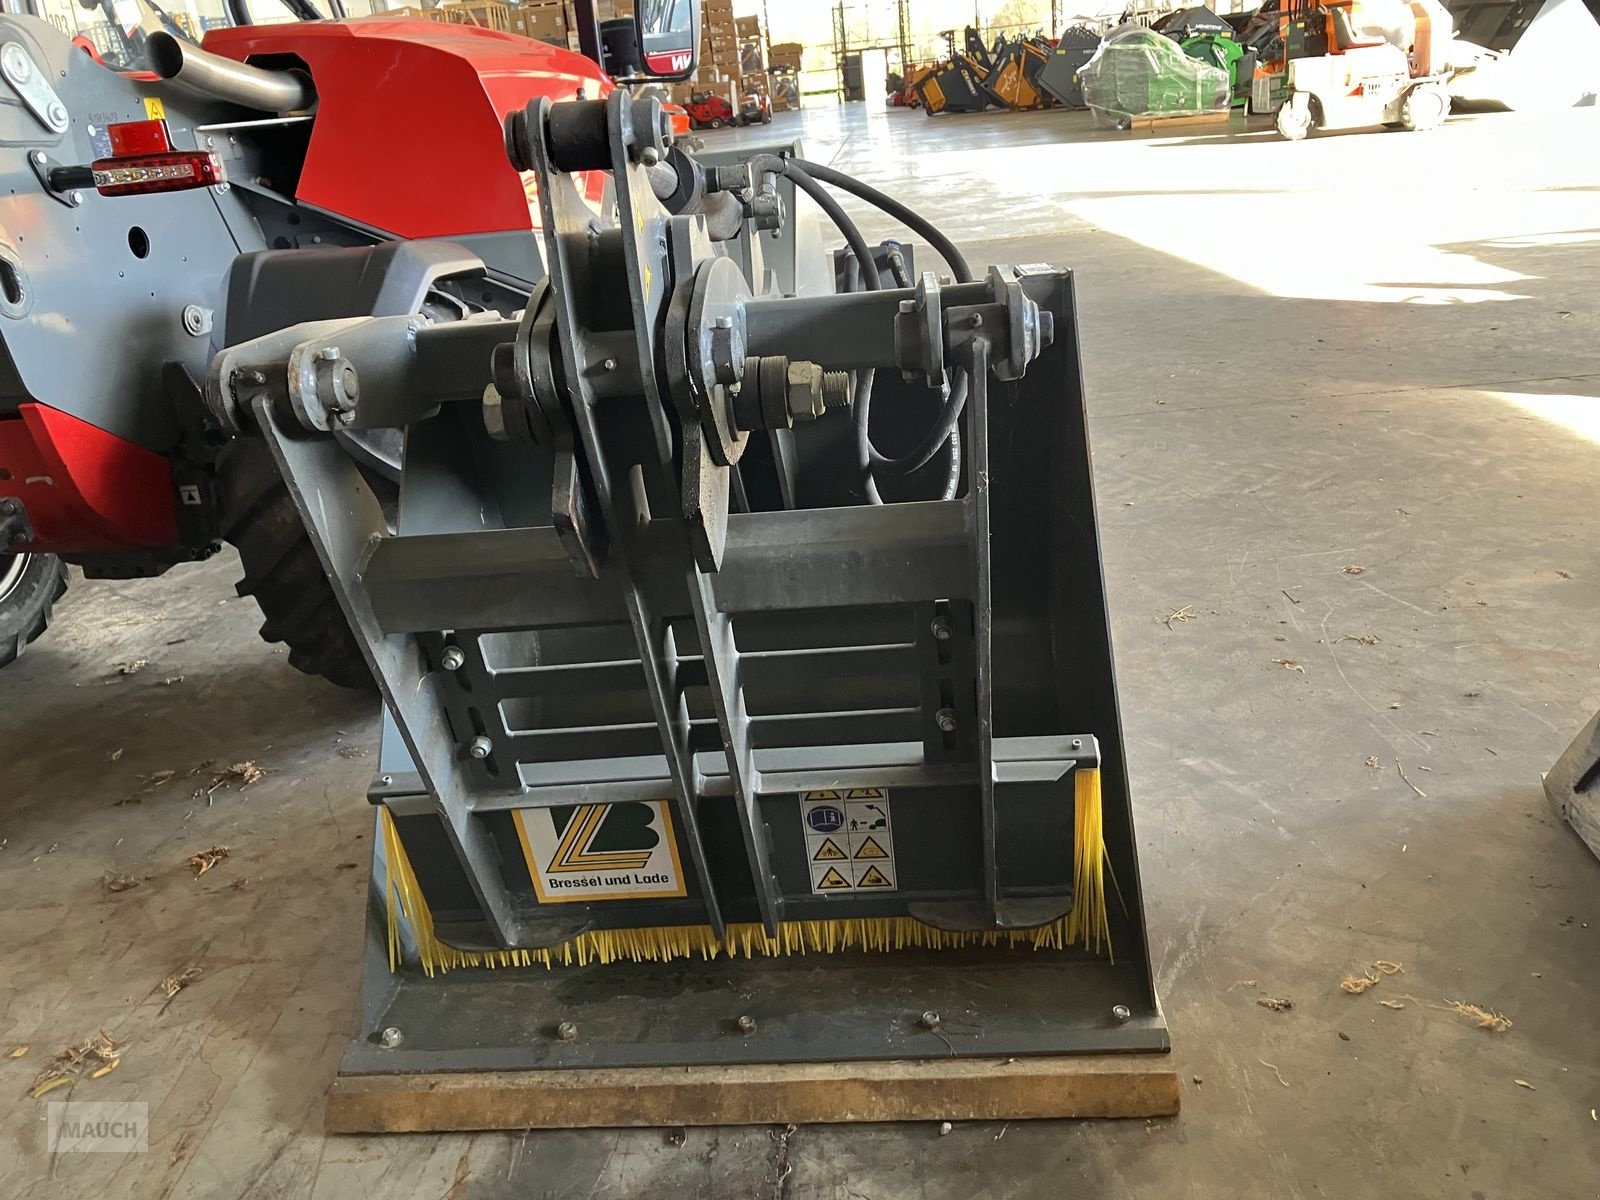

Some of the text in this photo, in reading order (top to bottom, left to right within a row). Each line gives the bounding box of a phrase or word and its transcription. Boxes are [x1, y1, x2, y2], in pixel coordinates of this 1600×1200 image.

[548, 873, 669, 889] Bressel und Lade
